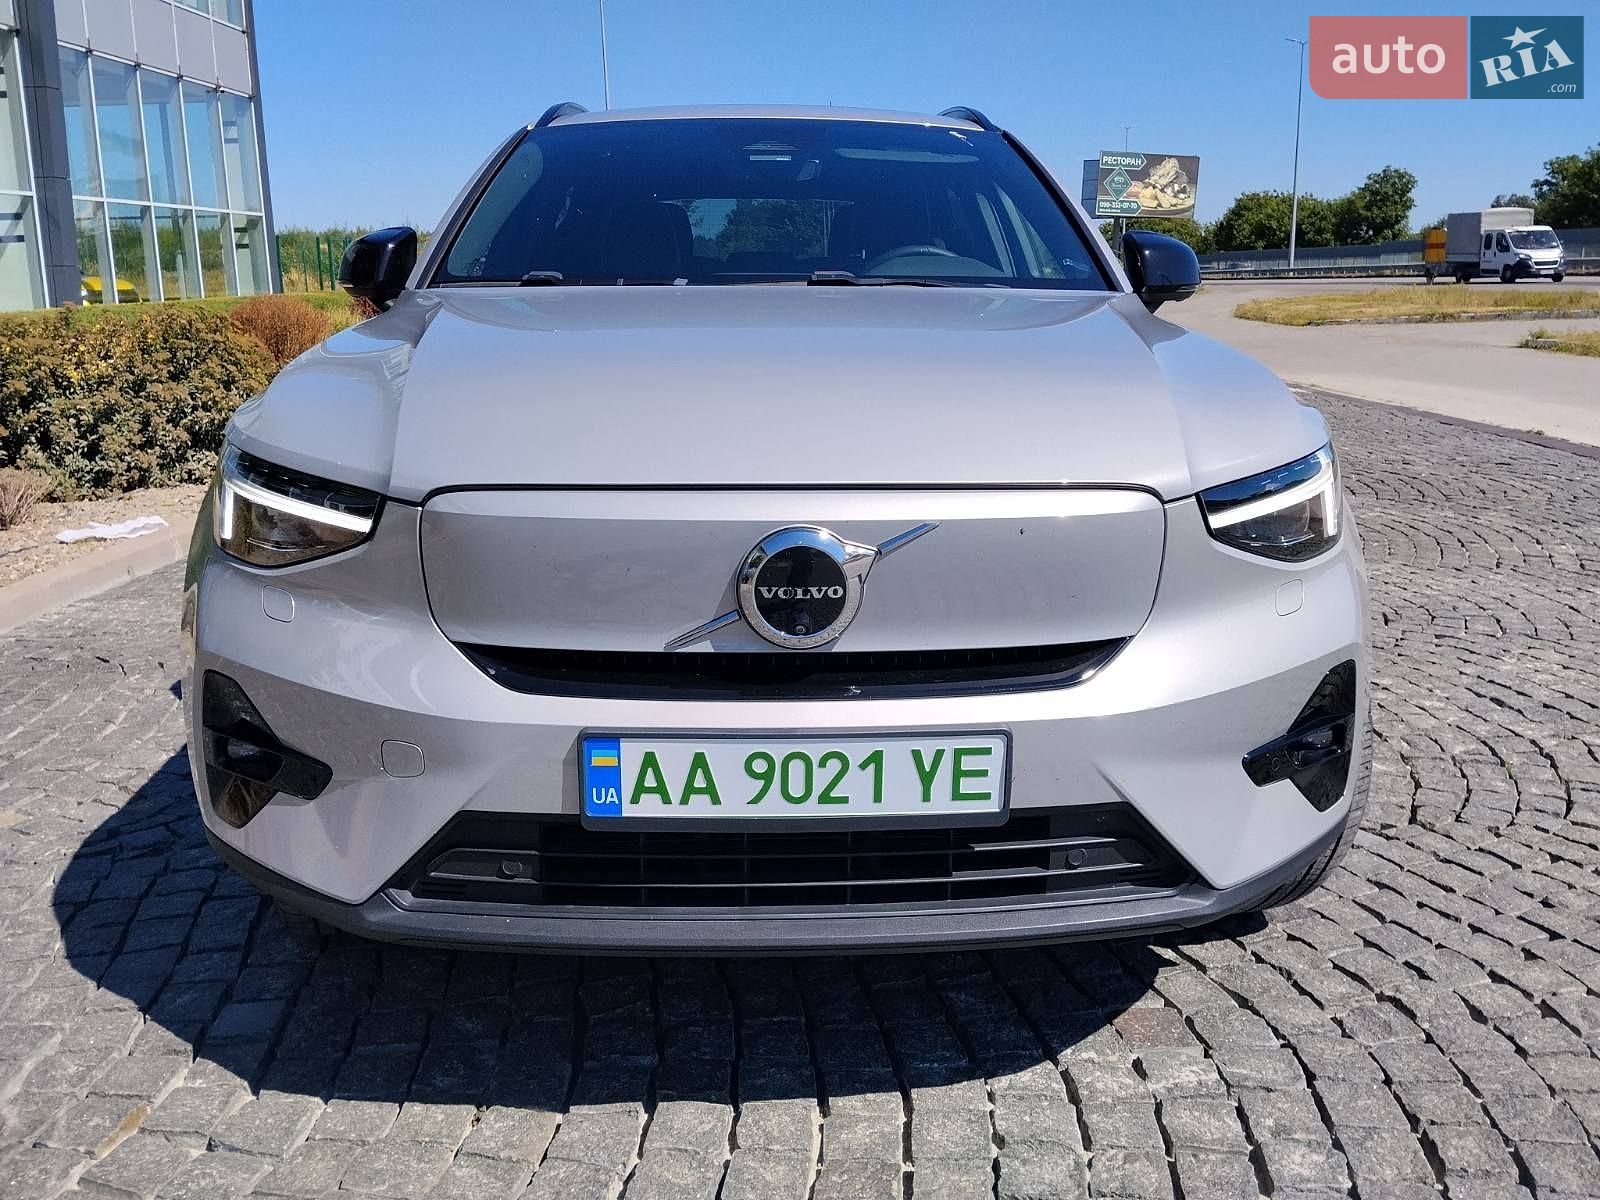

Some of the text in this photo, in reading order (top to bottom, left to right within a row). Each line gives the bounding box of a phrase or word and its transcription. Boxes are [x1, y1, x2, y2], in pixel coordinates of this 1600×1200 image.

[1102, 156, 1142, 166] РЕСТОРАН
[758, 585, 844, 599] VOLVO
[629, 746, 993, 806] AA 9021 YE
[592, 787, 619, 804] UA
